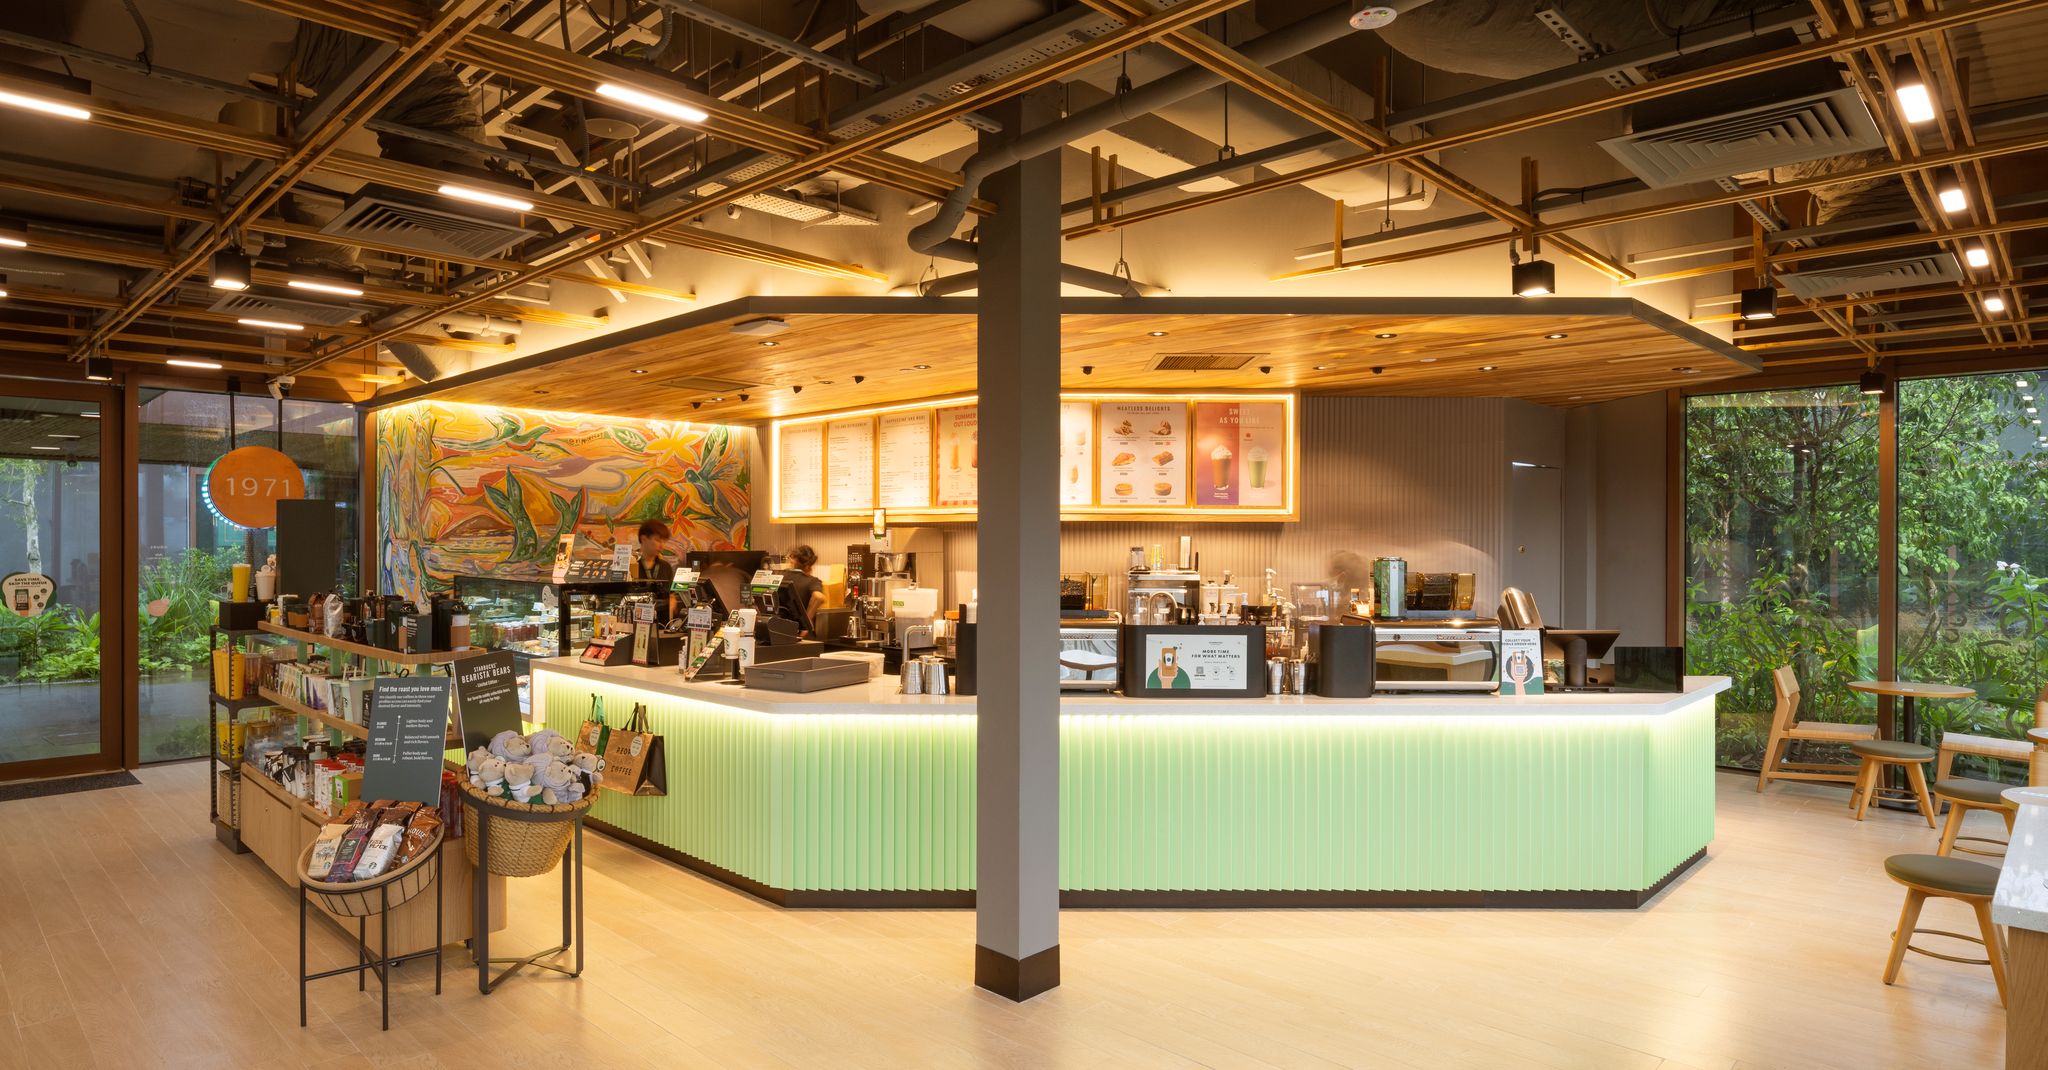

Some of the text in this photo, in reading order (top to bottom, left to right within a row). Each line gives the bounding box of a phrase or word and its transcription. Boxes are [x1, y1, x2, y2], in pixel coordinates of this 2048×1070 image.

[226, 477, 290, 497] 1971
[492, 666, 511, 677] BEARS
[610, 765, 632, 776] COFFEE
